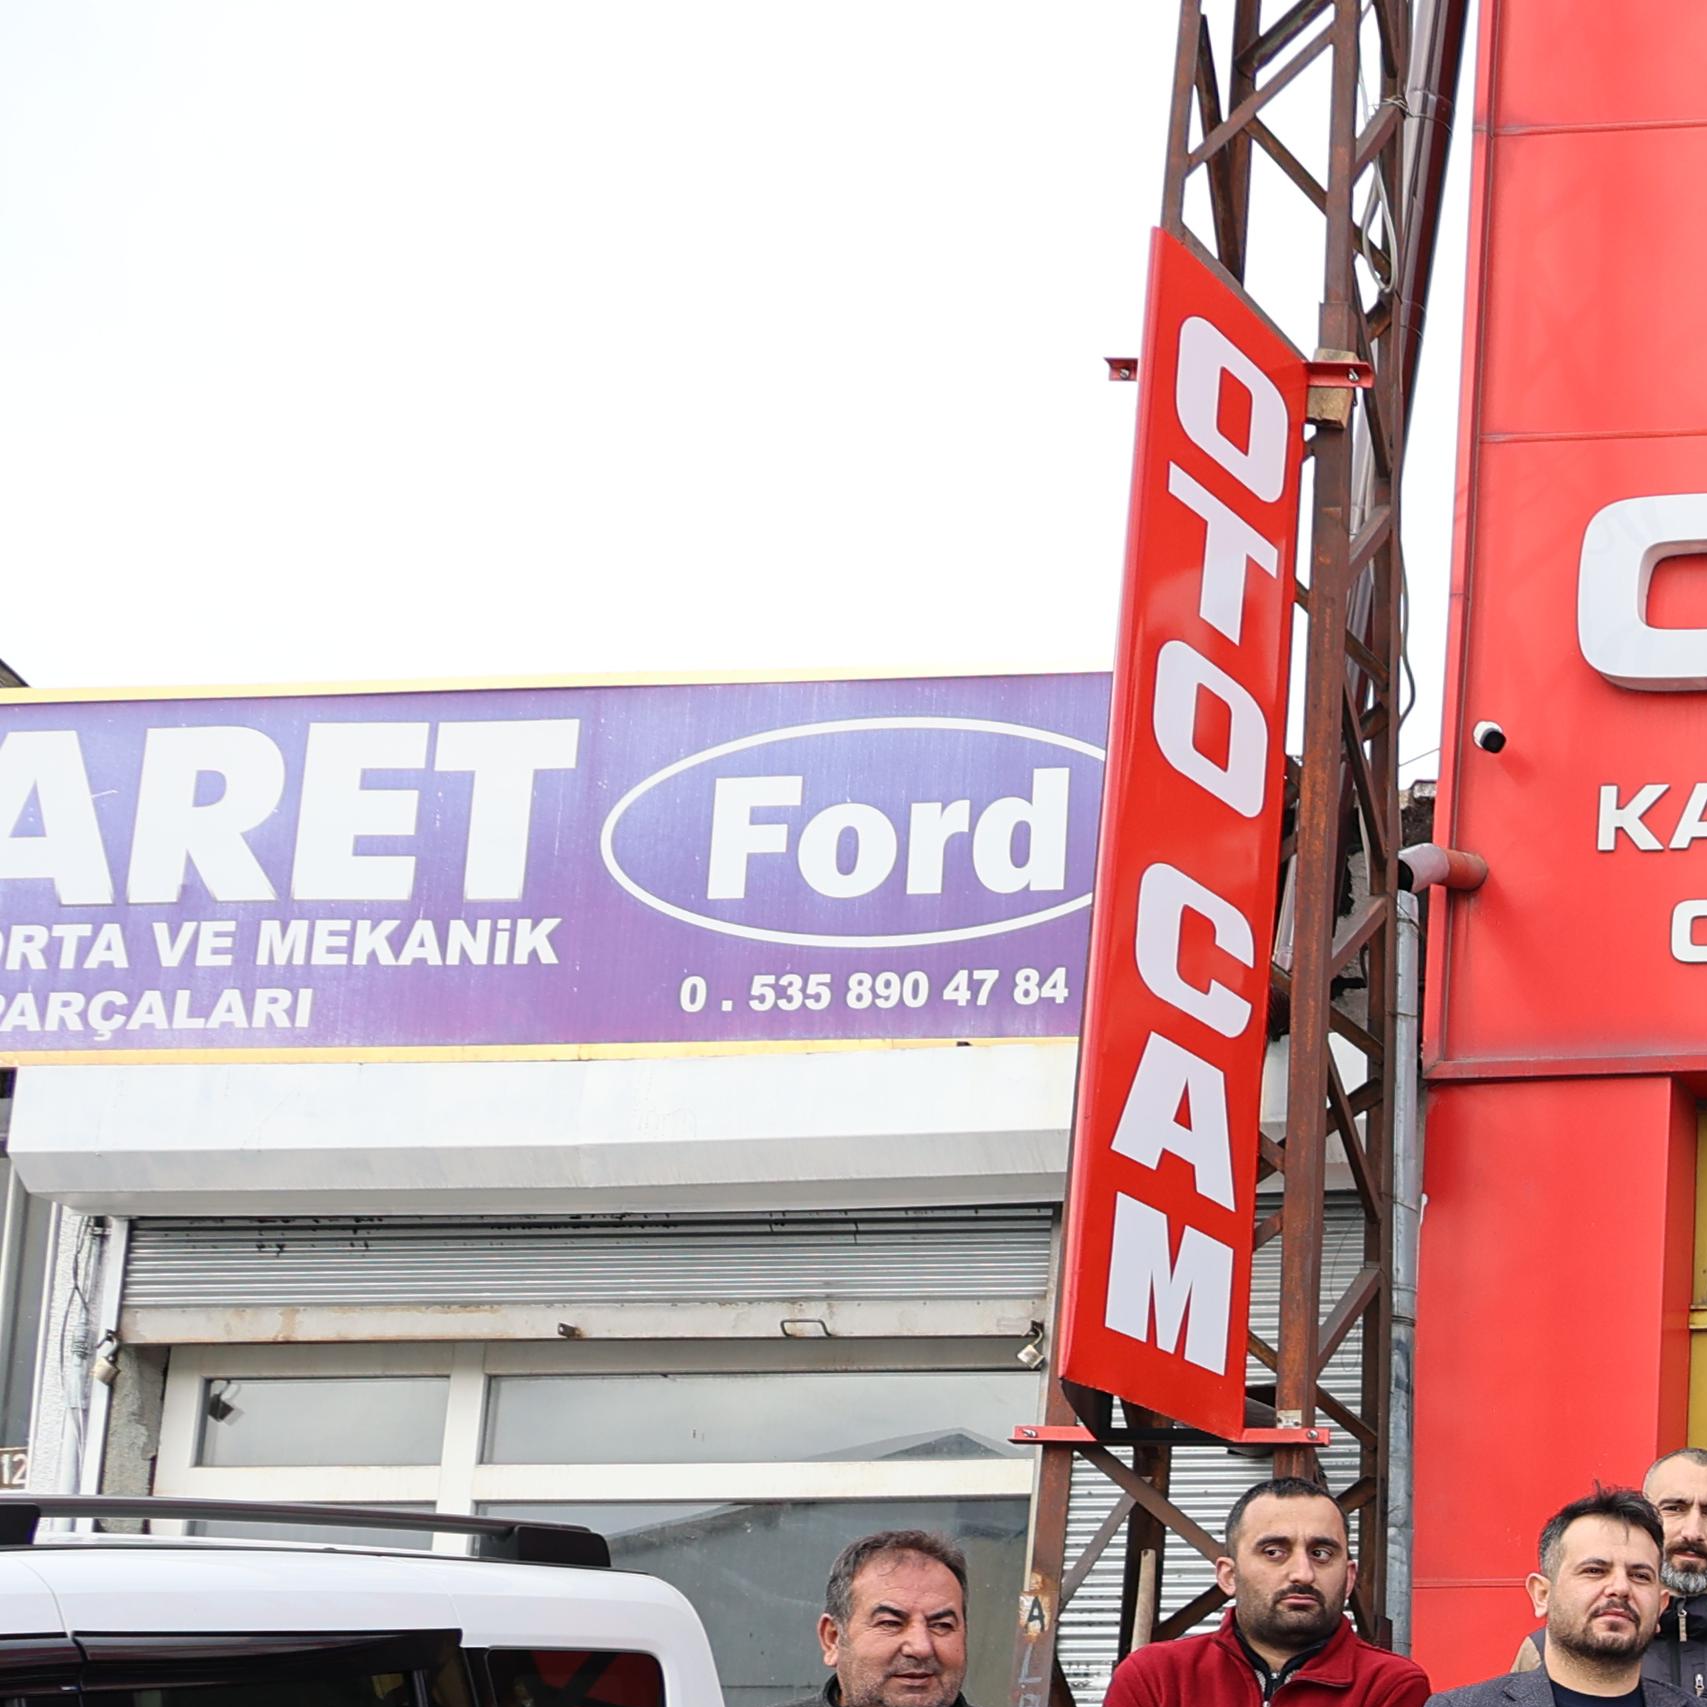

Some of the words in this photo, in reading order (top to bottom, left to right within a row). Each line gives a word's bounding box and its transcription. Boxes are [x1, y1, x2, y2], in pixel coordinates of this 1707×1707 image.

[1153, 316, 1289, 819] OTO
[706, 766, 1070, 900] Ford
[0, 922, 129, 971] RTA
[152, 920, 237, 968] VE
[748, 973, 832, 1012] 535
[846, 970, 930, 1010] 890
[943, 968, 1001, 1007] 47
[1013, 967, 1070, 1005] 84
[1105, 862, 1255, 1377] CAM
